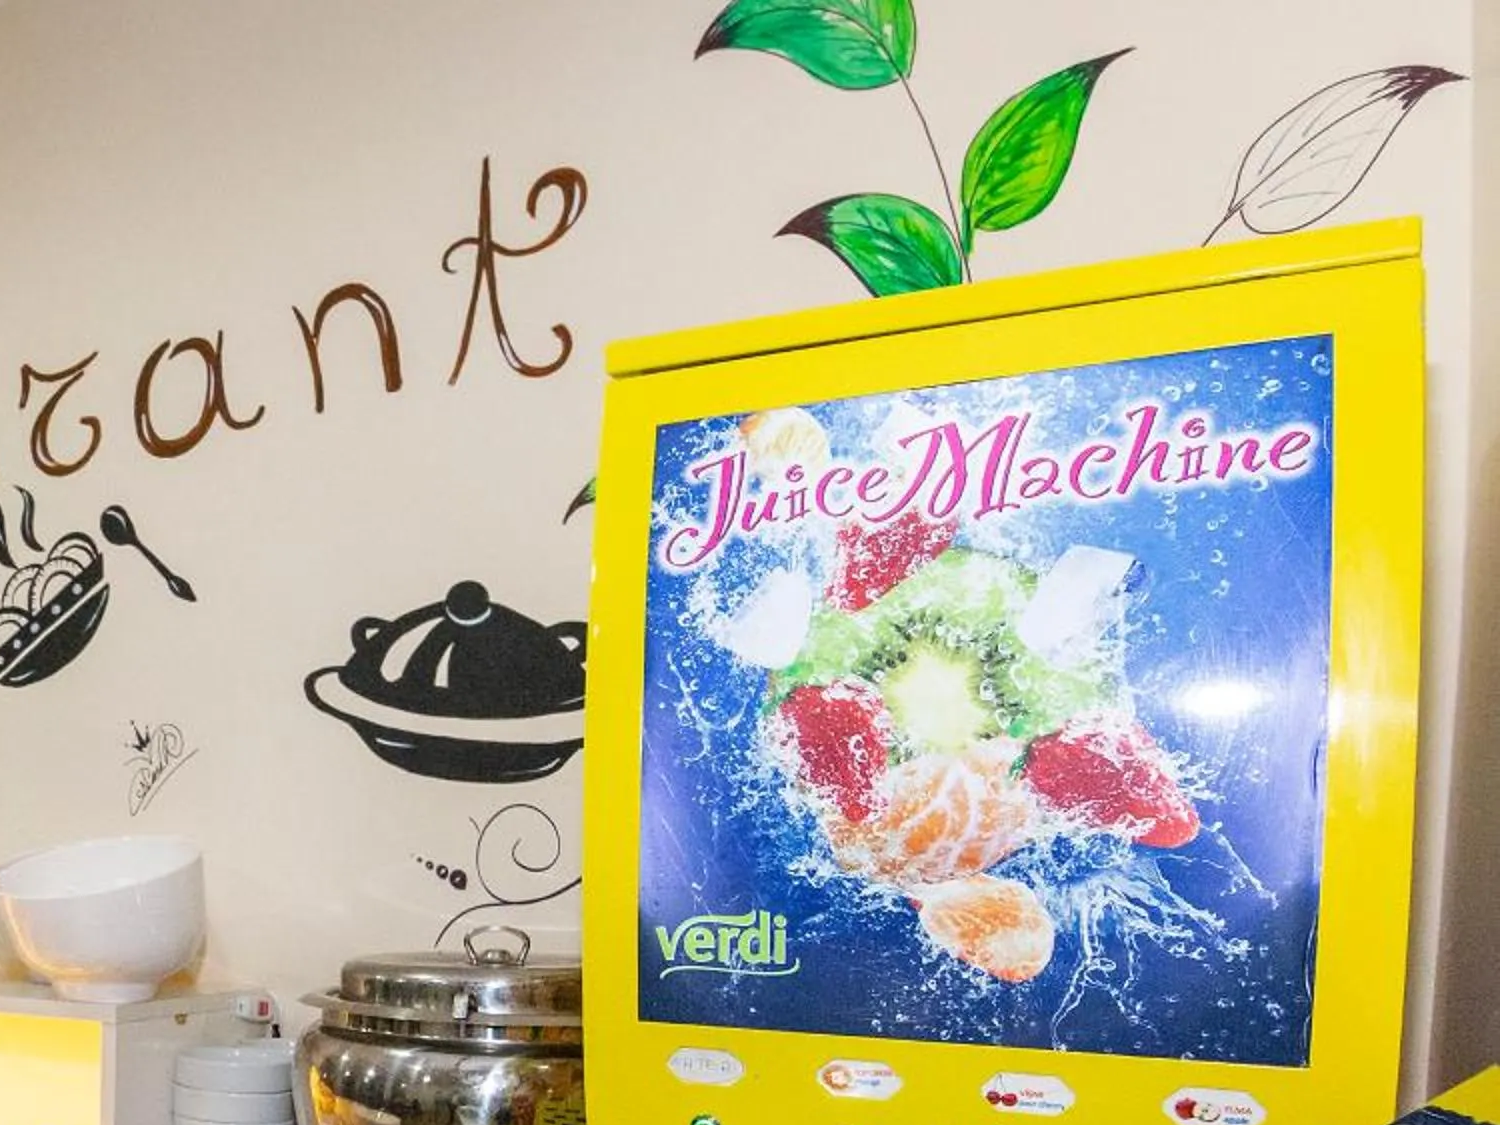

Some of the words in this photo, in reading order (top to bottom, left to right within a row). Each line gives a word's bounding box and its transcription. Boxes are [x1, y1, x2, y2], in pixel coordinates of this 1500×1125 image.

[664, 450, 890, 567] Juice
[864, 404, 1312, 522] Machine
[655, 909, 788, 965] verdi
